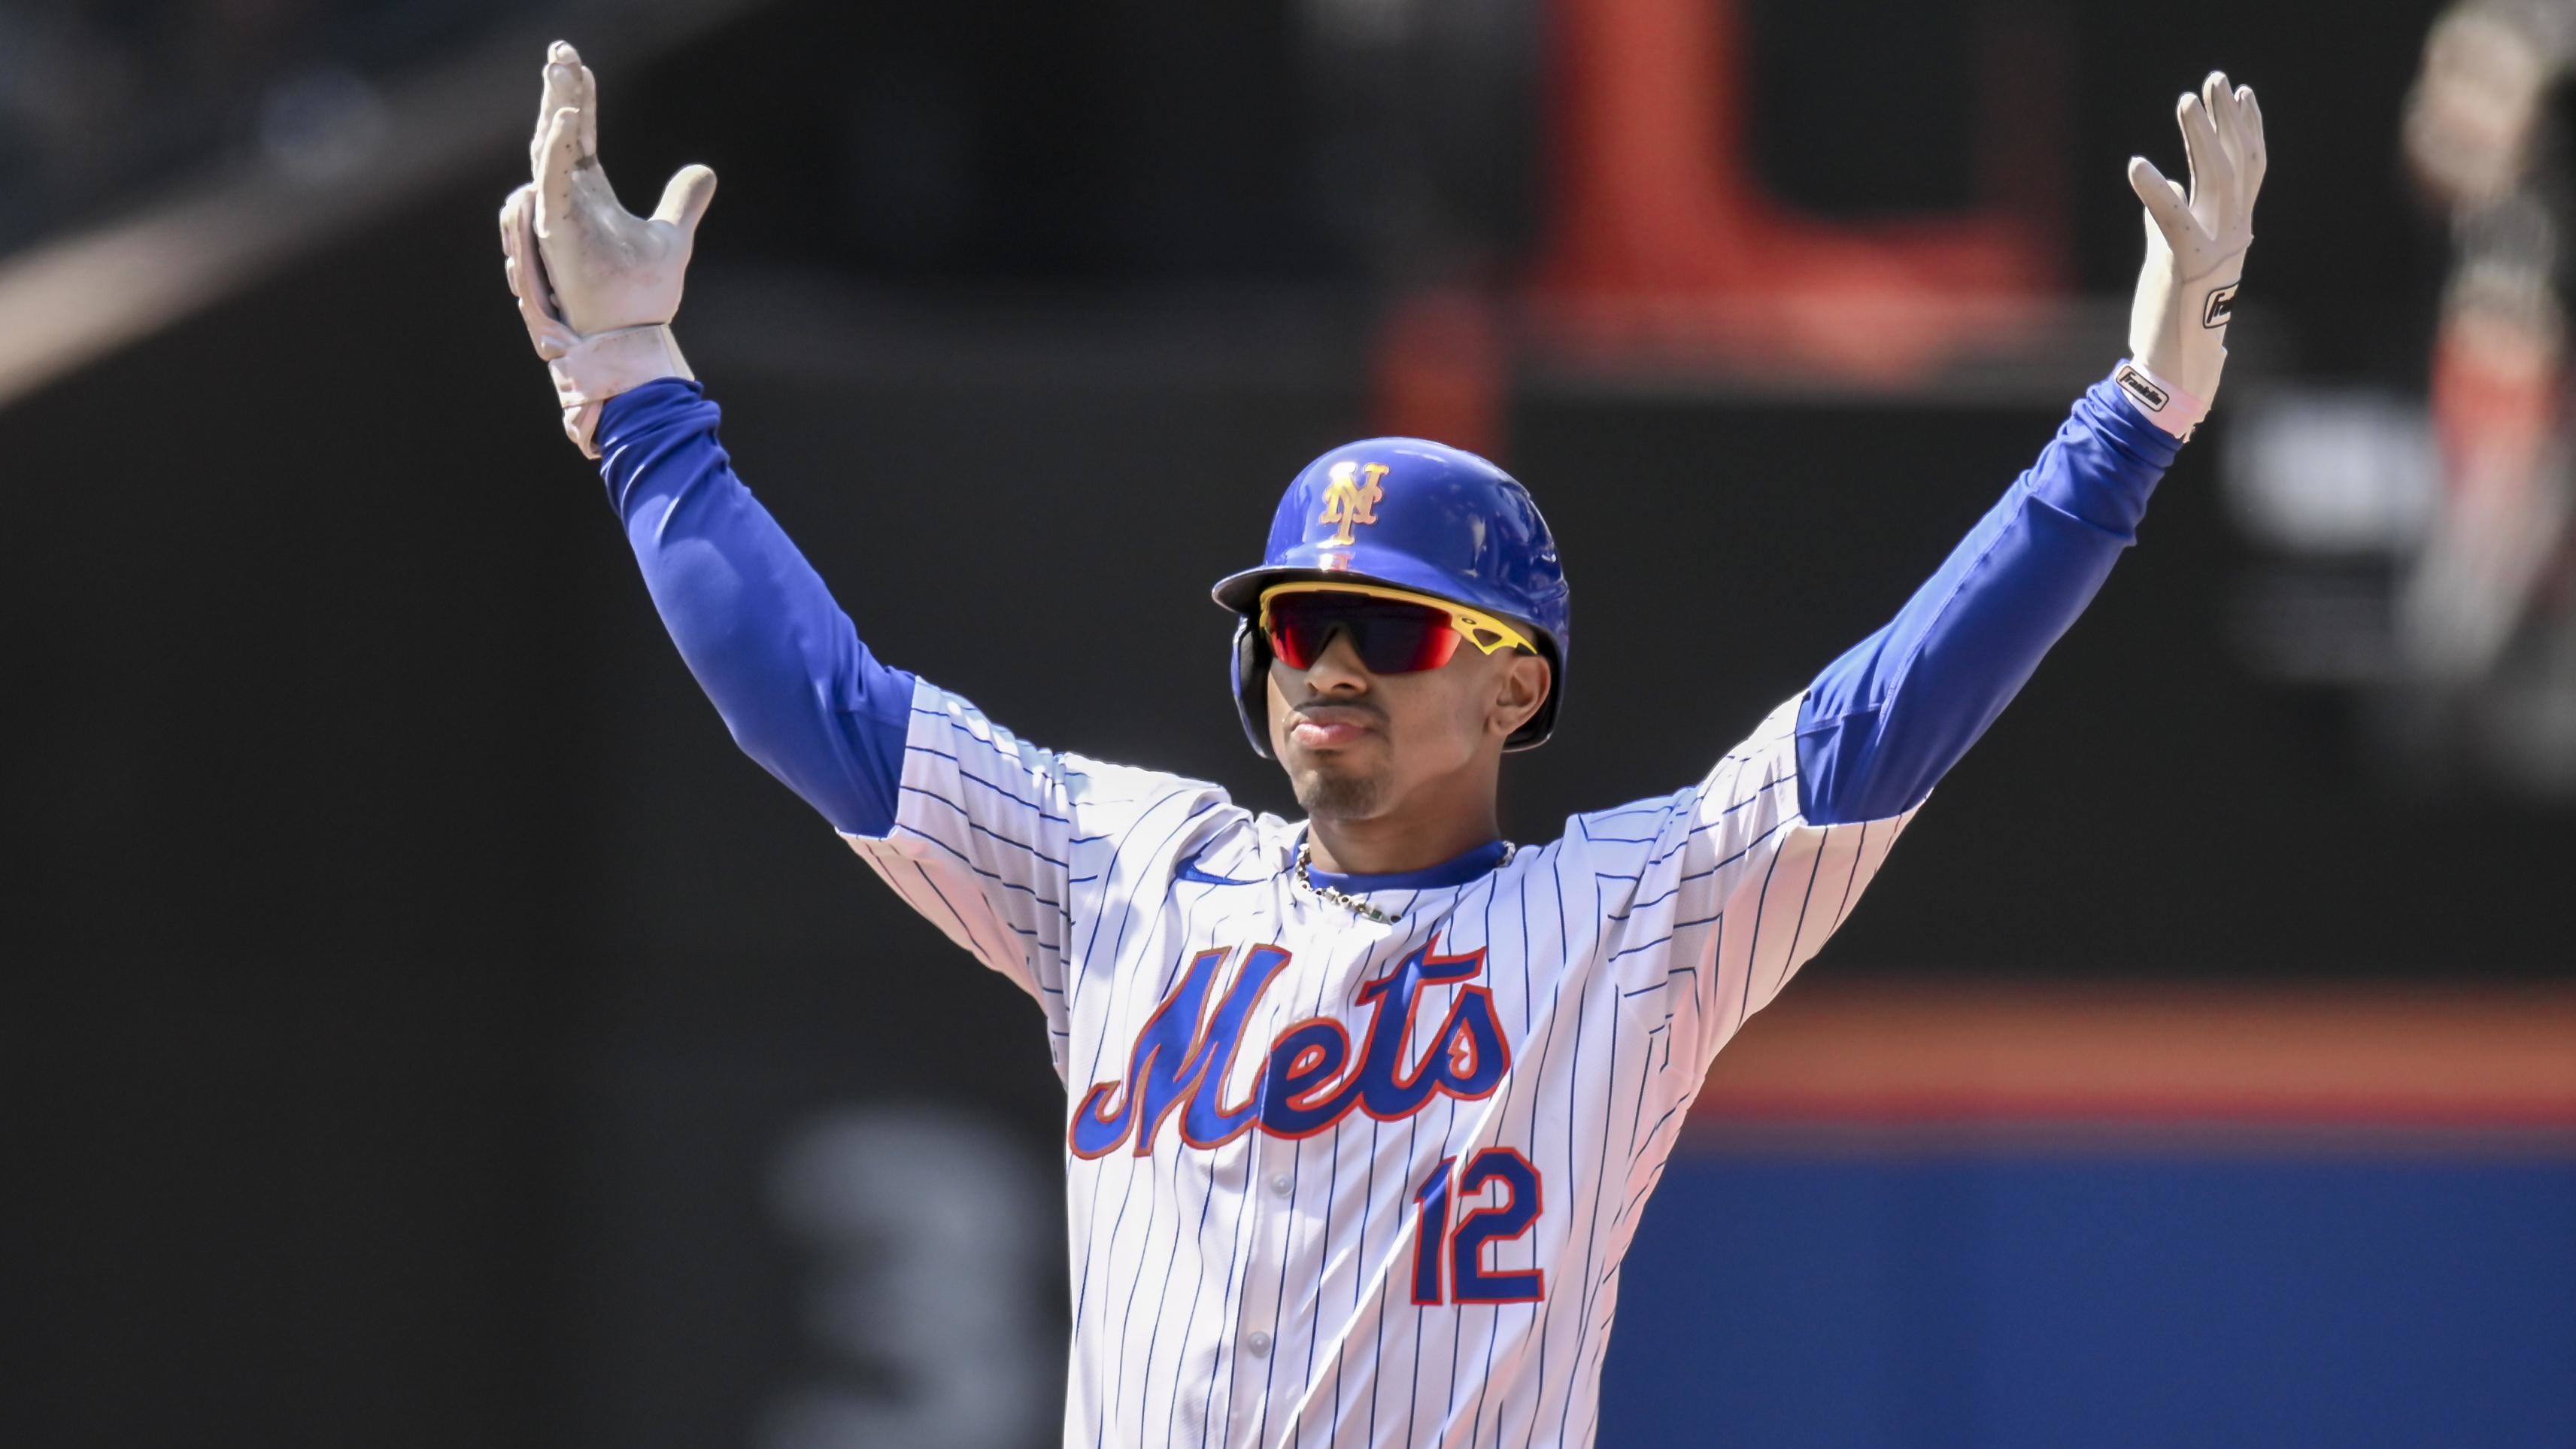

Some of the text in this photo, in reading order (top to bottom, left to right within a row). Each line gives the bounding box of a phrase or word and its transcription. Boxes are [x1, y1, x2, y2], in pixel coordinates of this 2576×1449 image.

[2119, 371, 2162, 406] Franklin
[1319, 461, 1391, 546] NY
[1068, 931, 1511, 1160] Mets
[1411, 1147, 1545, 1305] 12
